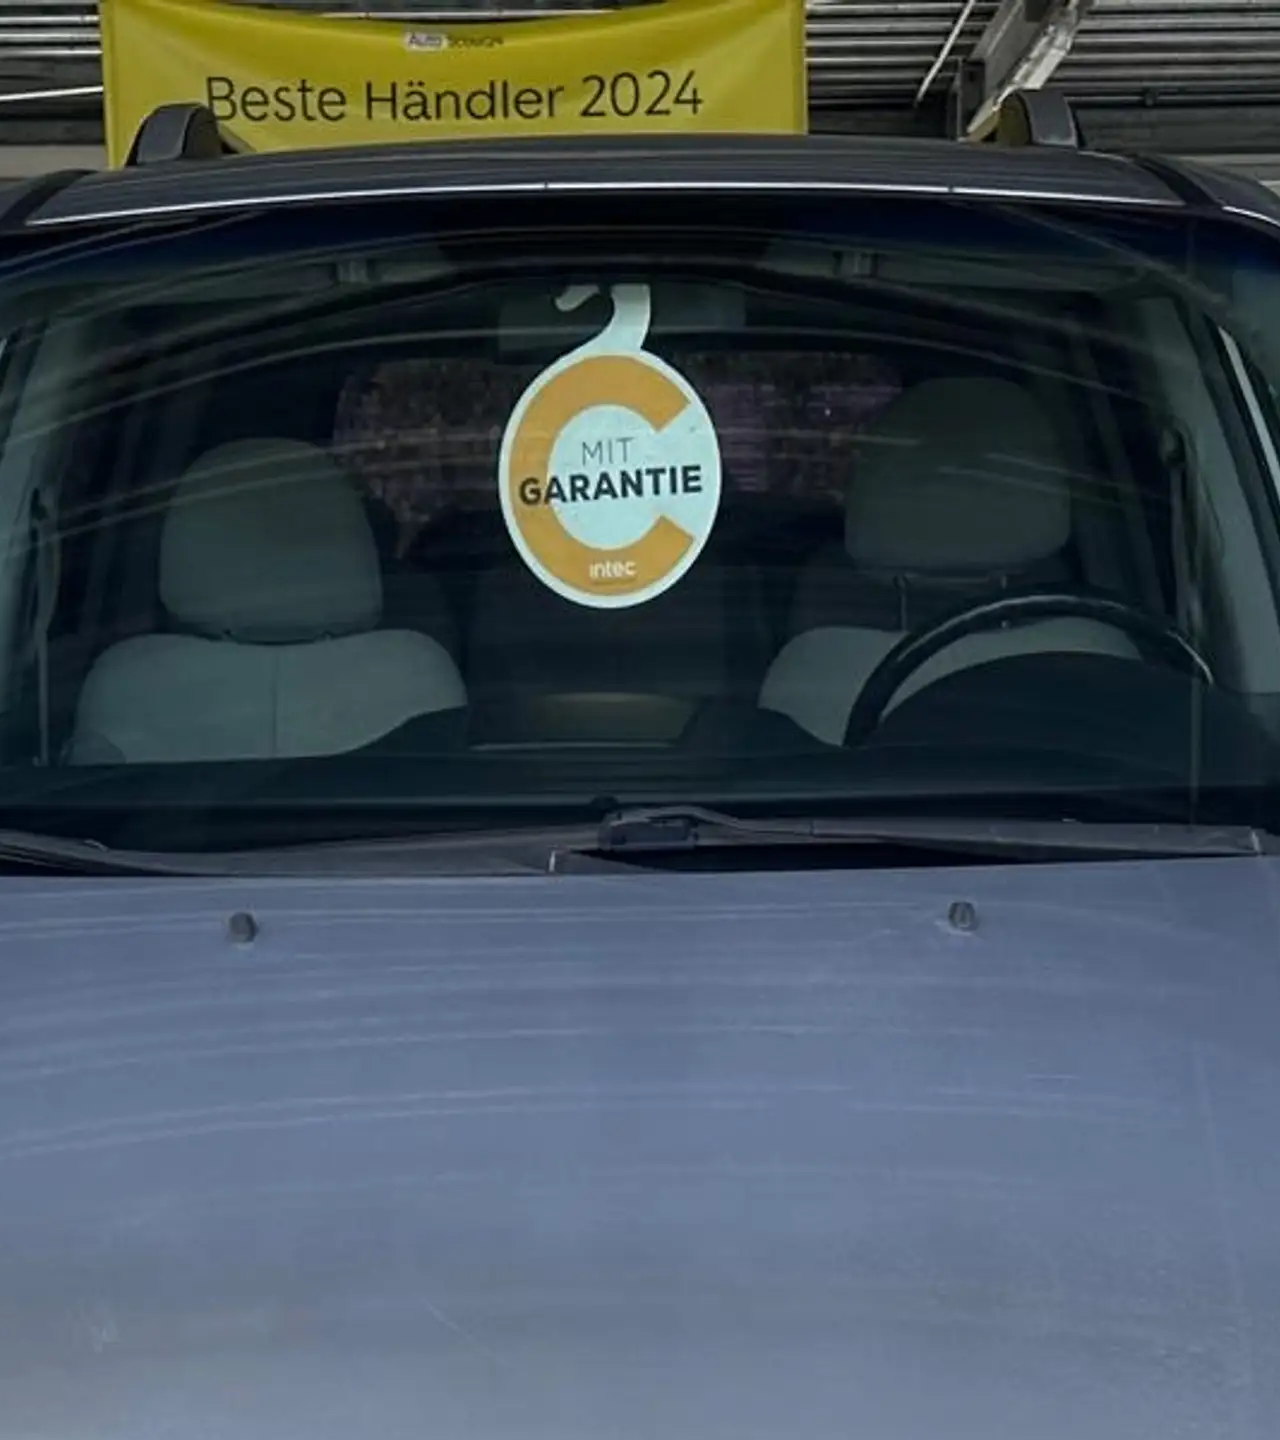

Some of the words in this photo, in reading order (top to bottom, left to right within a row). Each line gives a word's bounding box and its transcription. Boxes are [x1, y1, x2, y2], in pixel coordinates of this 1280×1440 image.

[206, 75, 346, 123] Beste
[365, 76, 565, 122] Händler
[581, 70, 704, 119] 2024
[581, 437, 634, 466] MIT
[518, 465, 703, 505] GARANTIE
